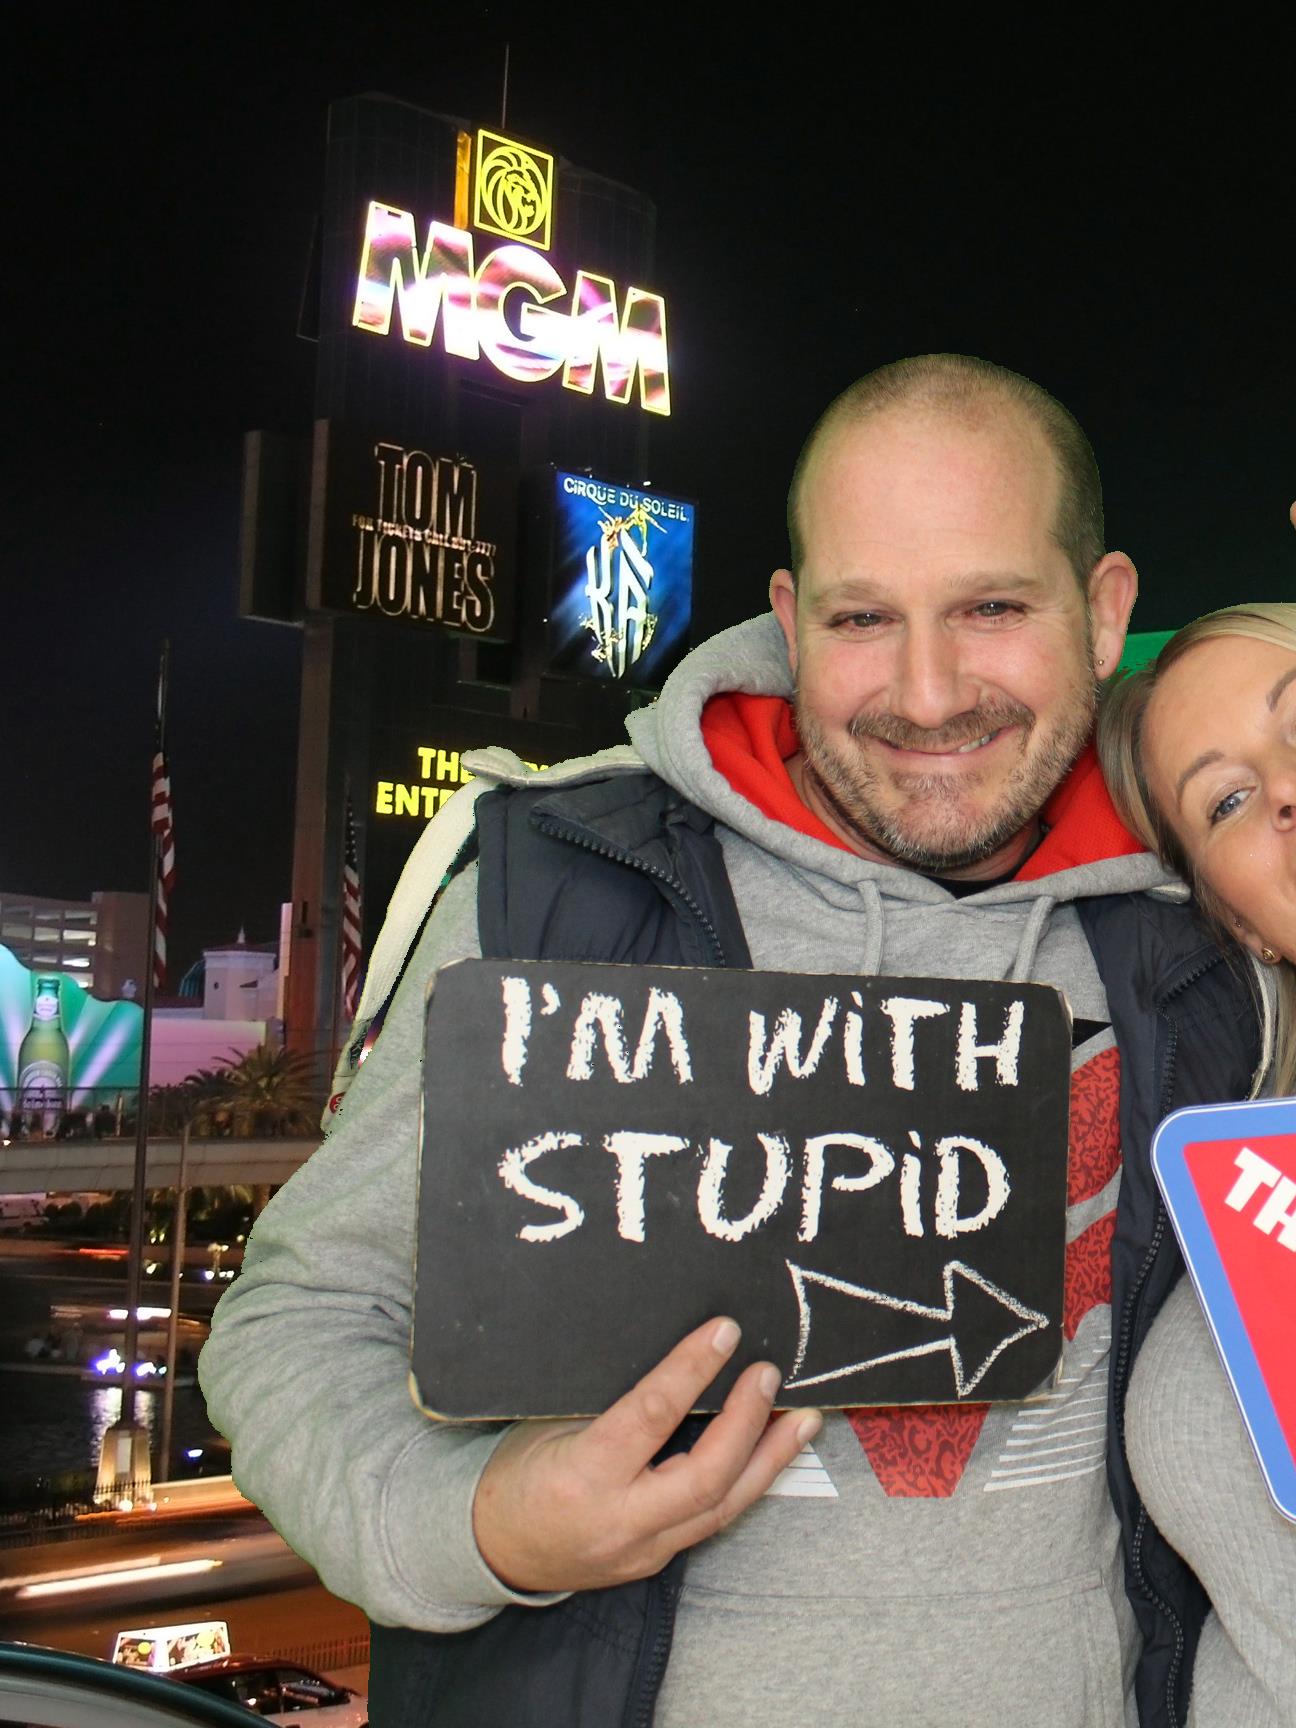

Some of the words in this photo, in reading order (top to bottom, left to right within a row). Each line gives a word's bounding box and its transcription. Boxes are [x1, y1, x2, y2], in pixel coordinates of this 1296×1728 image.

[353, 201, 671, 417] MGM
[374, 442, 477, 539] TOM
[352, 530, 495, 632] JONES
[501, 976, 694, 1087] I'M
